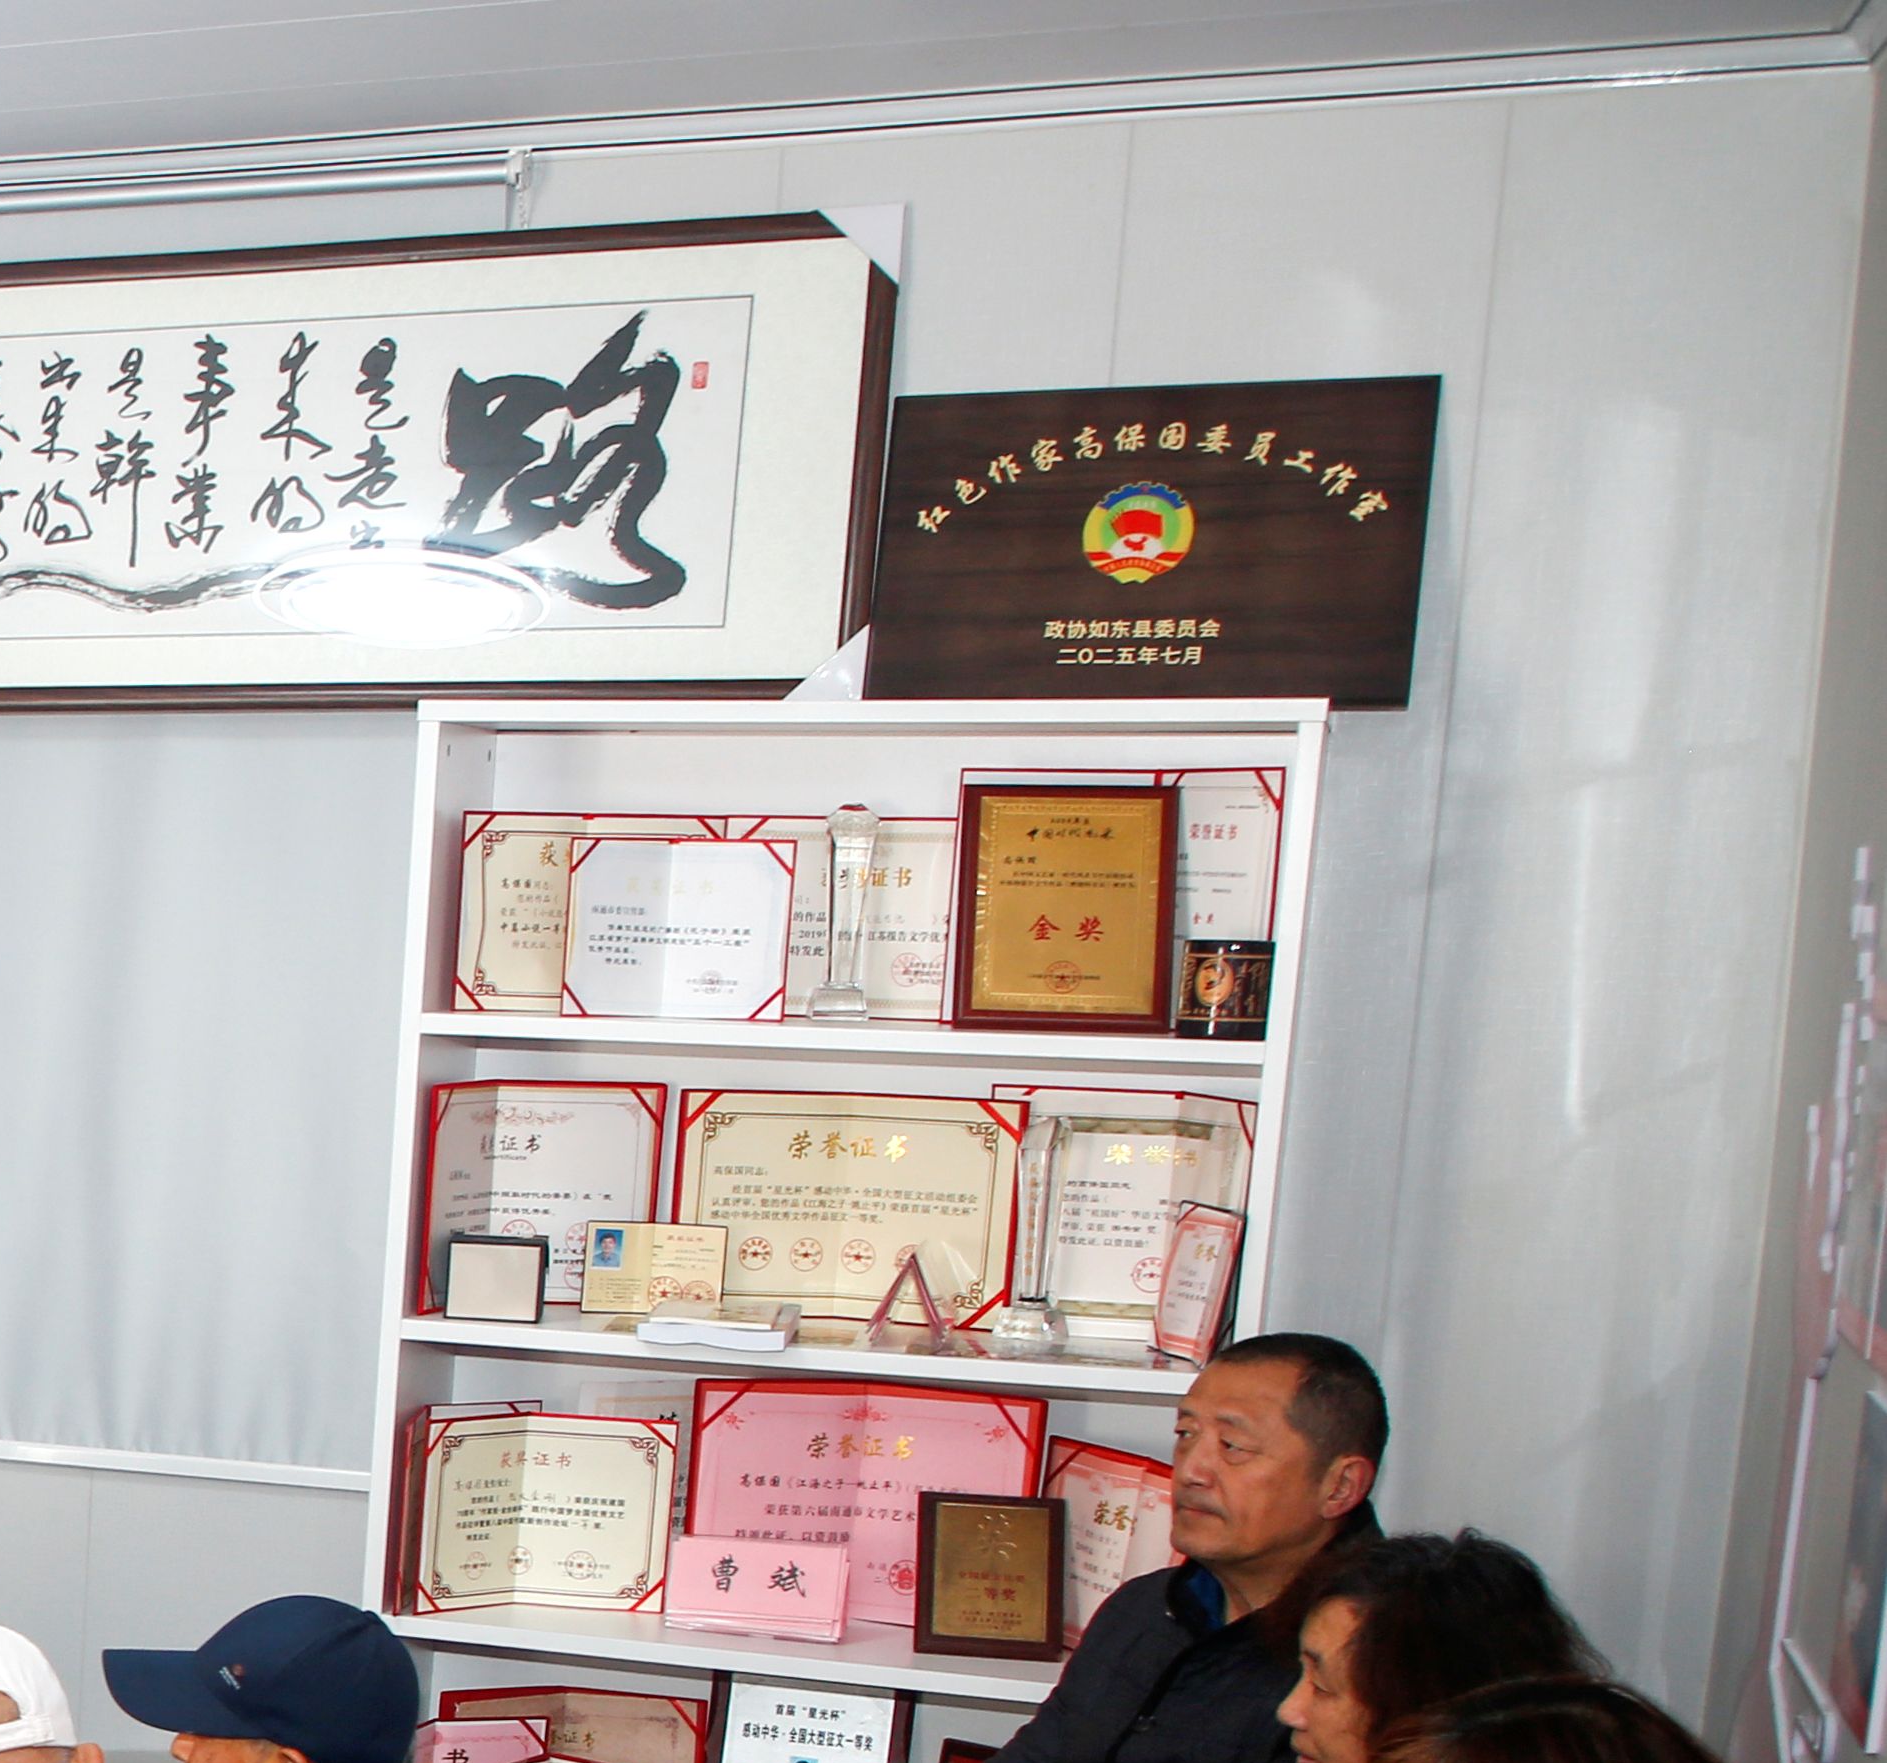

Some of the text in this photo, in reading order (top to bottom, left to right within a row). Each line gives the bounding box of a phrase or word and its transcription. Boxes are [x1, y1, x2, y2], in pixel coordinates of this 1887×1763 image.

[424, 308, 687, 610] 路
[916, 421, 1389, 533] 红色作家高保国委员工作室
[1043, 619, 1221, 639] 政协如东县委员会
[1028, 913, 1105, 942] 金奖
[788, 1130, 910, 1162] 荣誉证书
[807, 1433, 917, 1460] 荣誉证书
[775, 1703, 847, 1721] 首届“星光杯”
